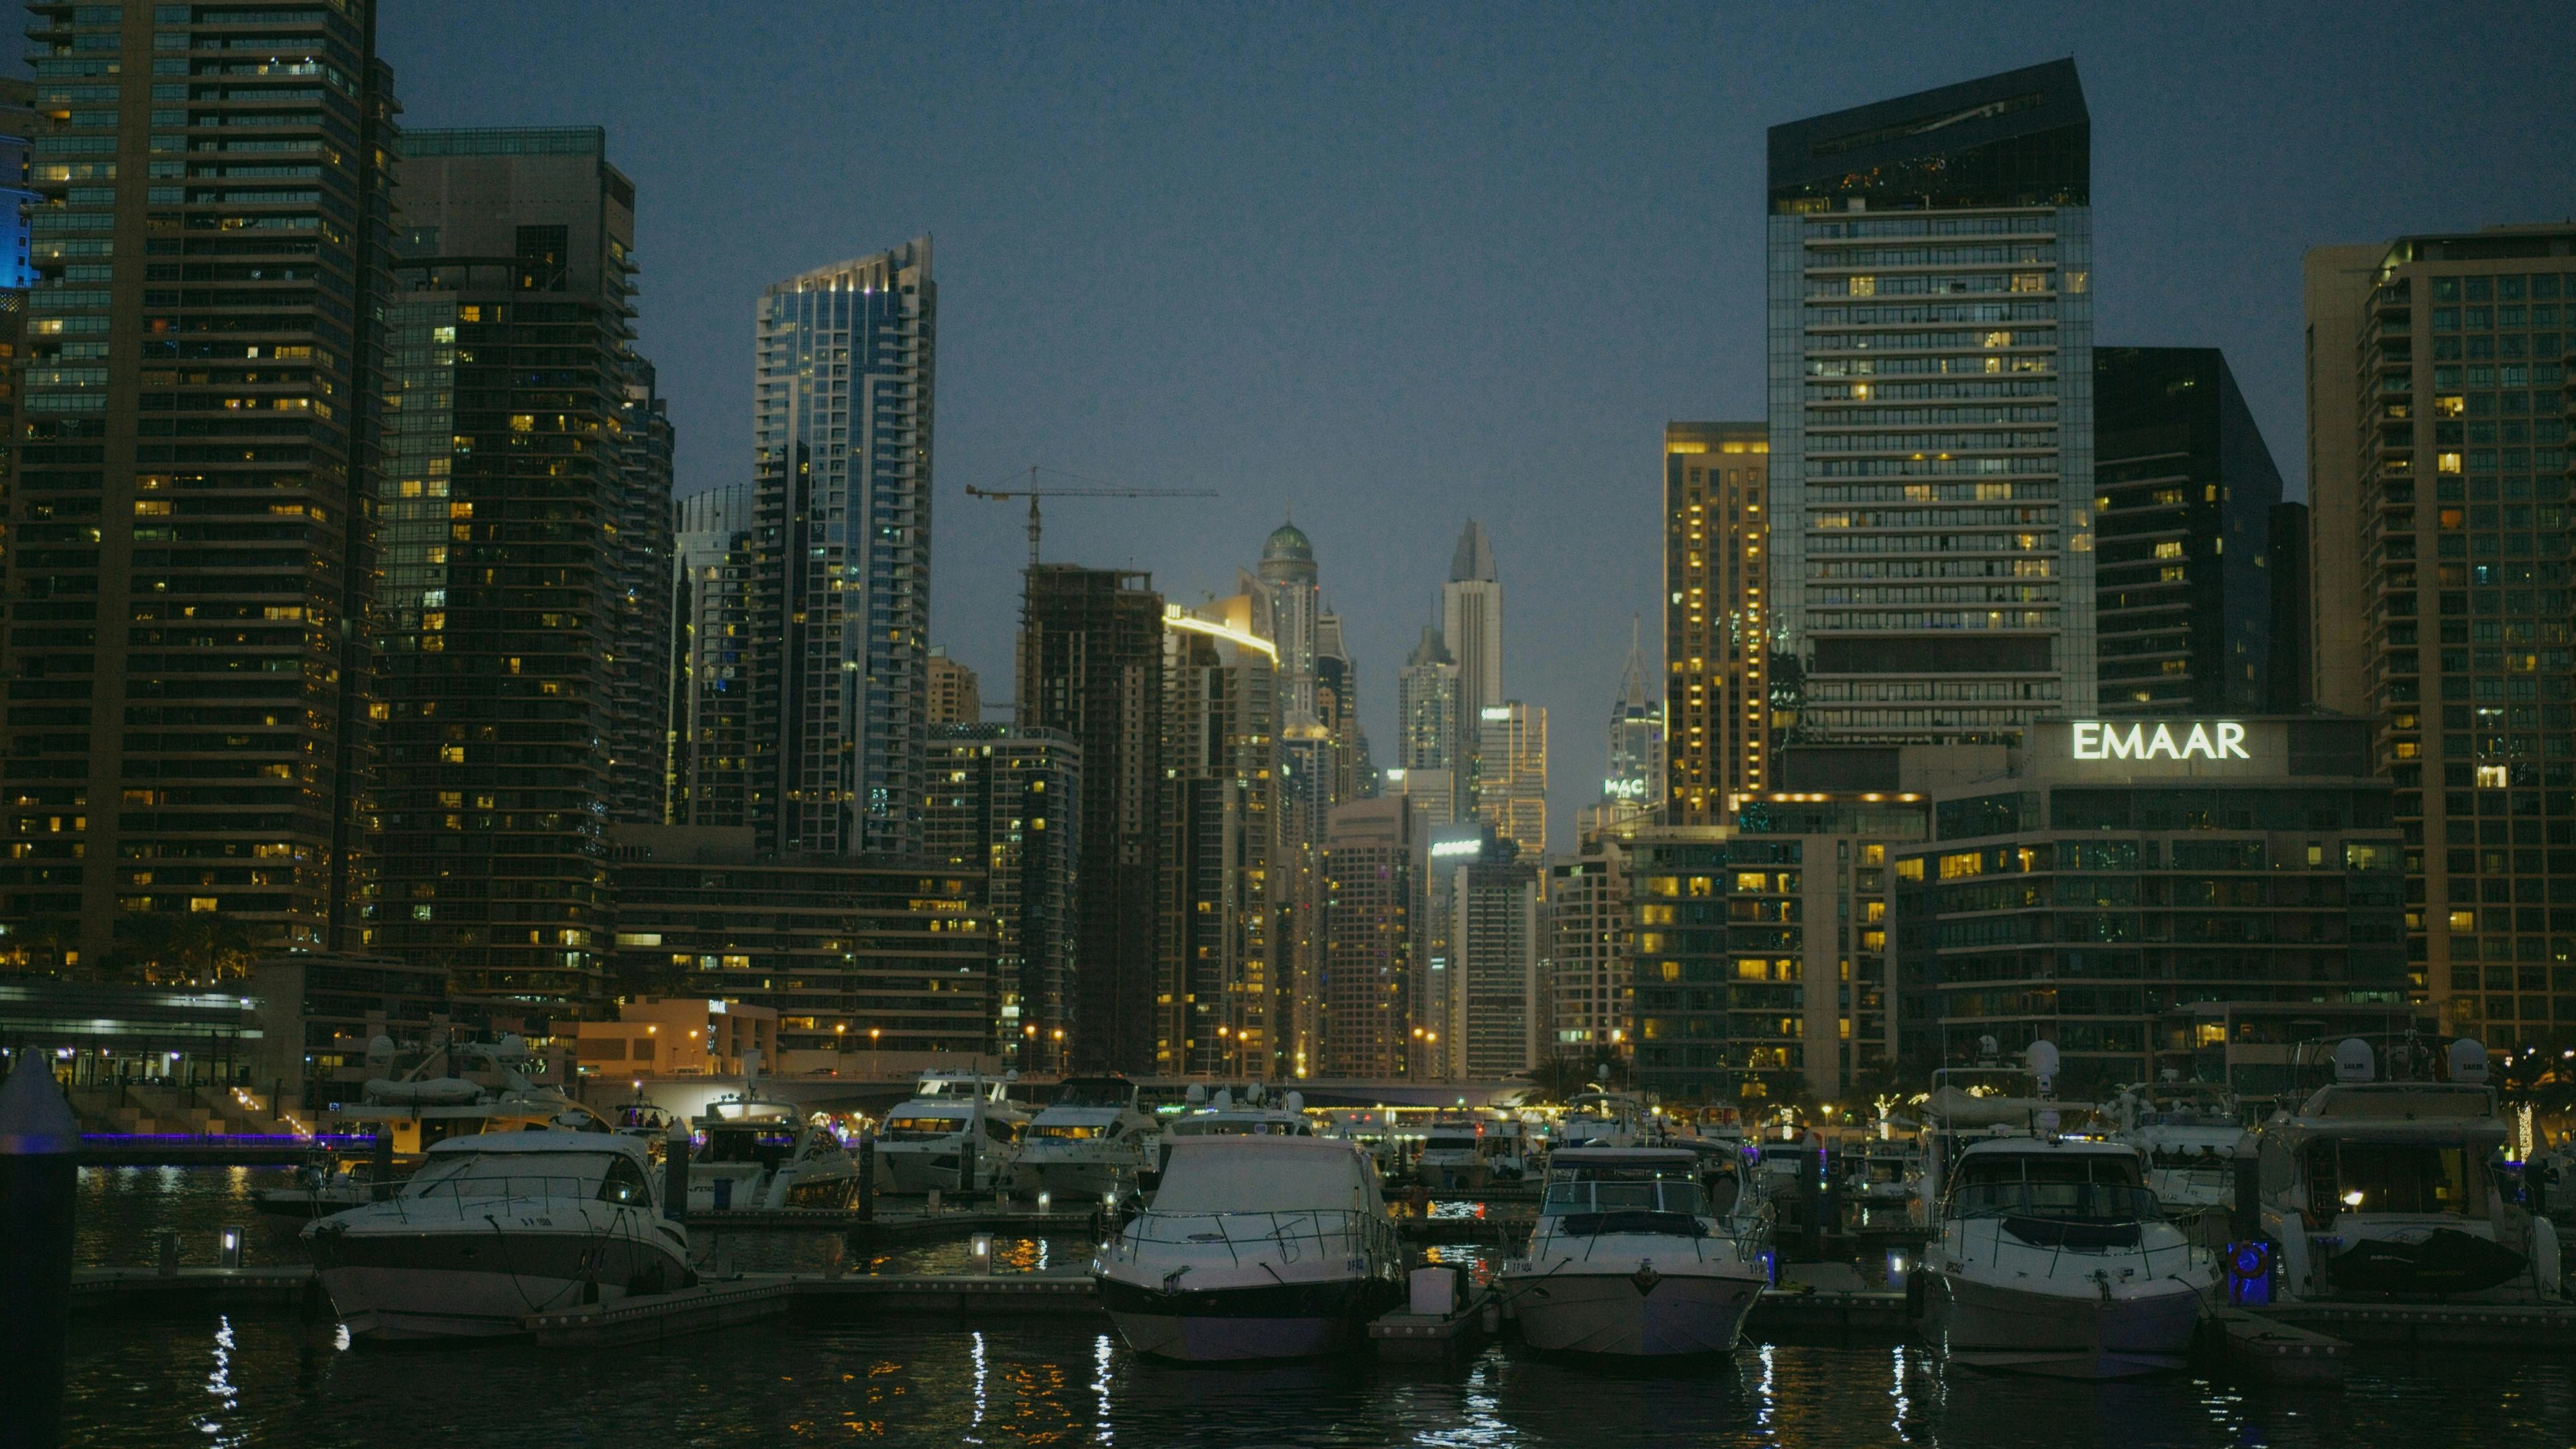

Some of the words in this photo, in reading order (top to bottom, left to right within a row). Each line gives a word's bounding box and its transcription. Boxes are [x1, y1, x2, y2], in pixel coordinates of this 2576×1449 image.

[2072, 722, 2251, 759] EMAAR
[860, 1151, 871, 1165] G
[1827, 1160, 1839, 1175] G
